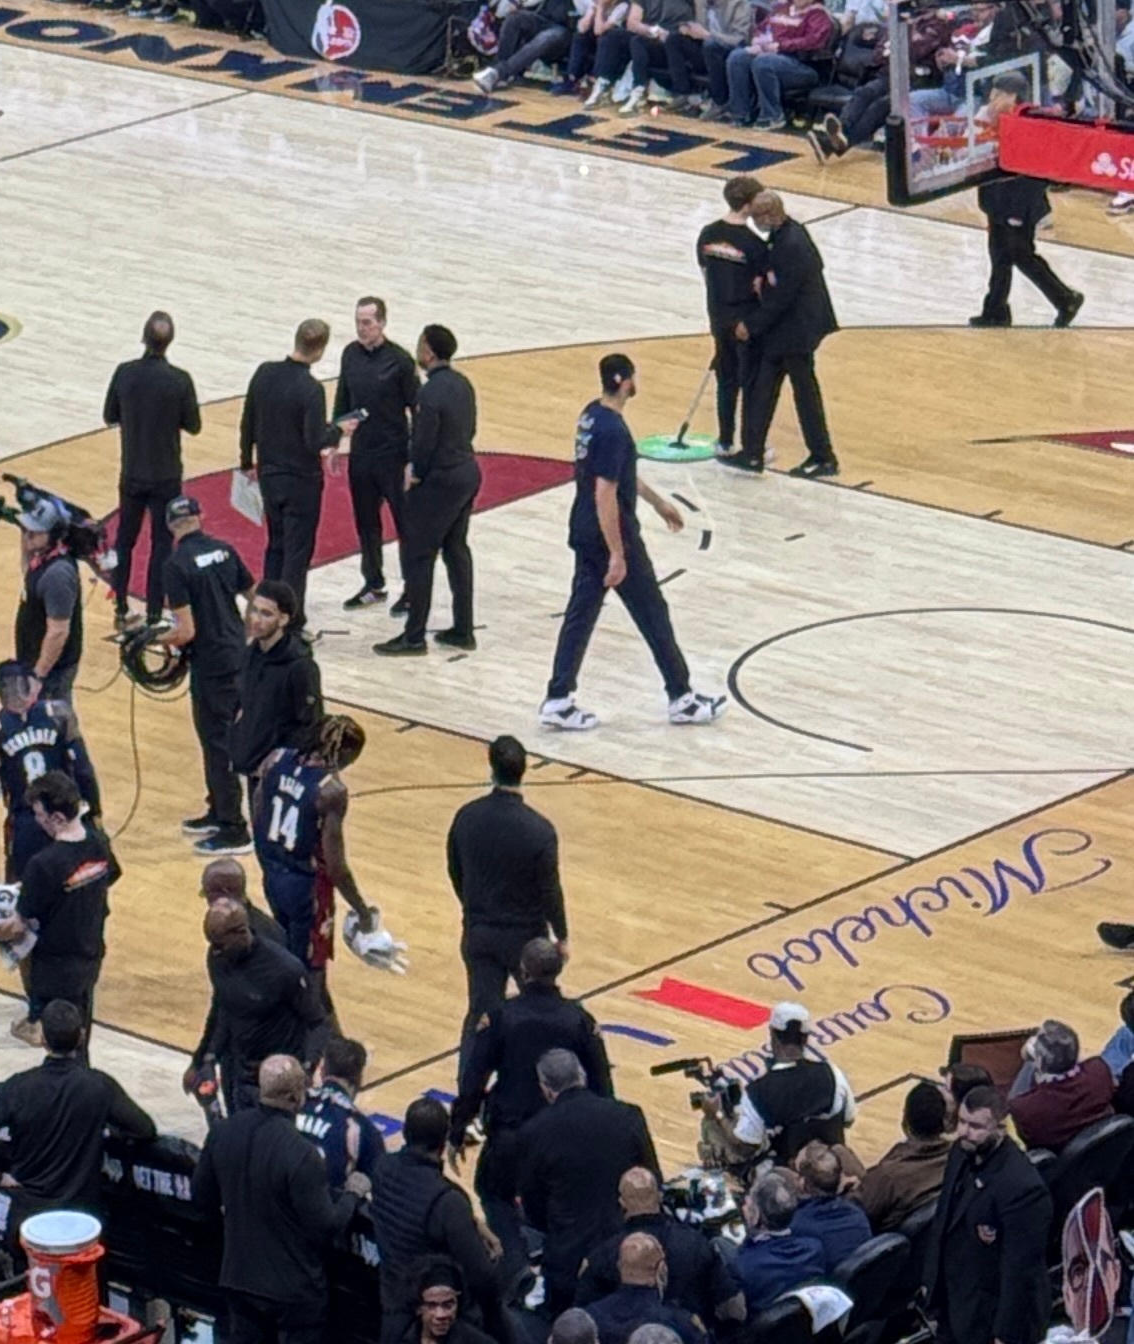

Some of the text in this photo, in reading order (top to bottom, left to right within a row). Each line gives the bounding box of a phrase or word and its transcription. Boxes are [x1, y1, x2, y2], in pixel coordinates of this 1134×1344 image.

[268, 796, 300, 851] 14
[747, 827, 1112, 992] Michelob
[30, 1266, 51, 1299] G
